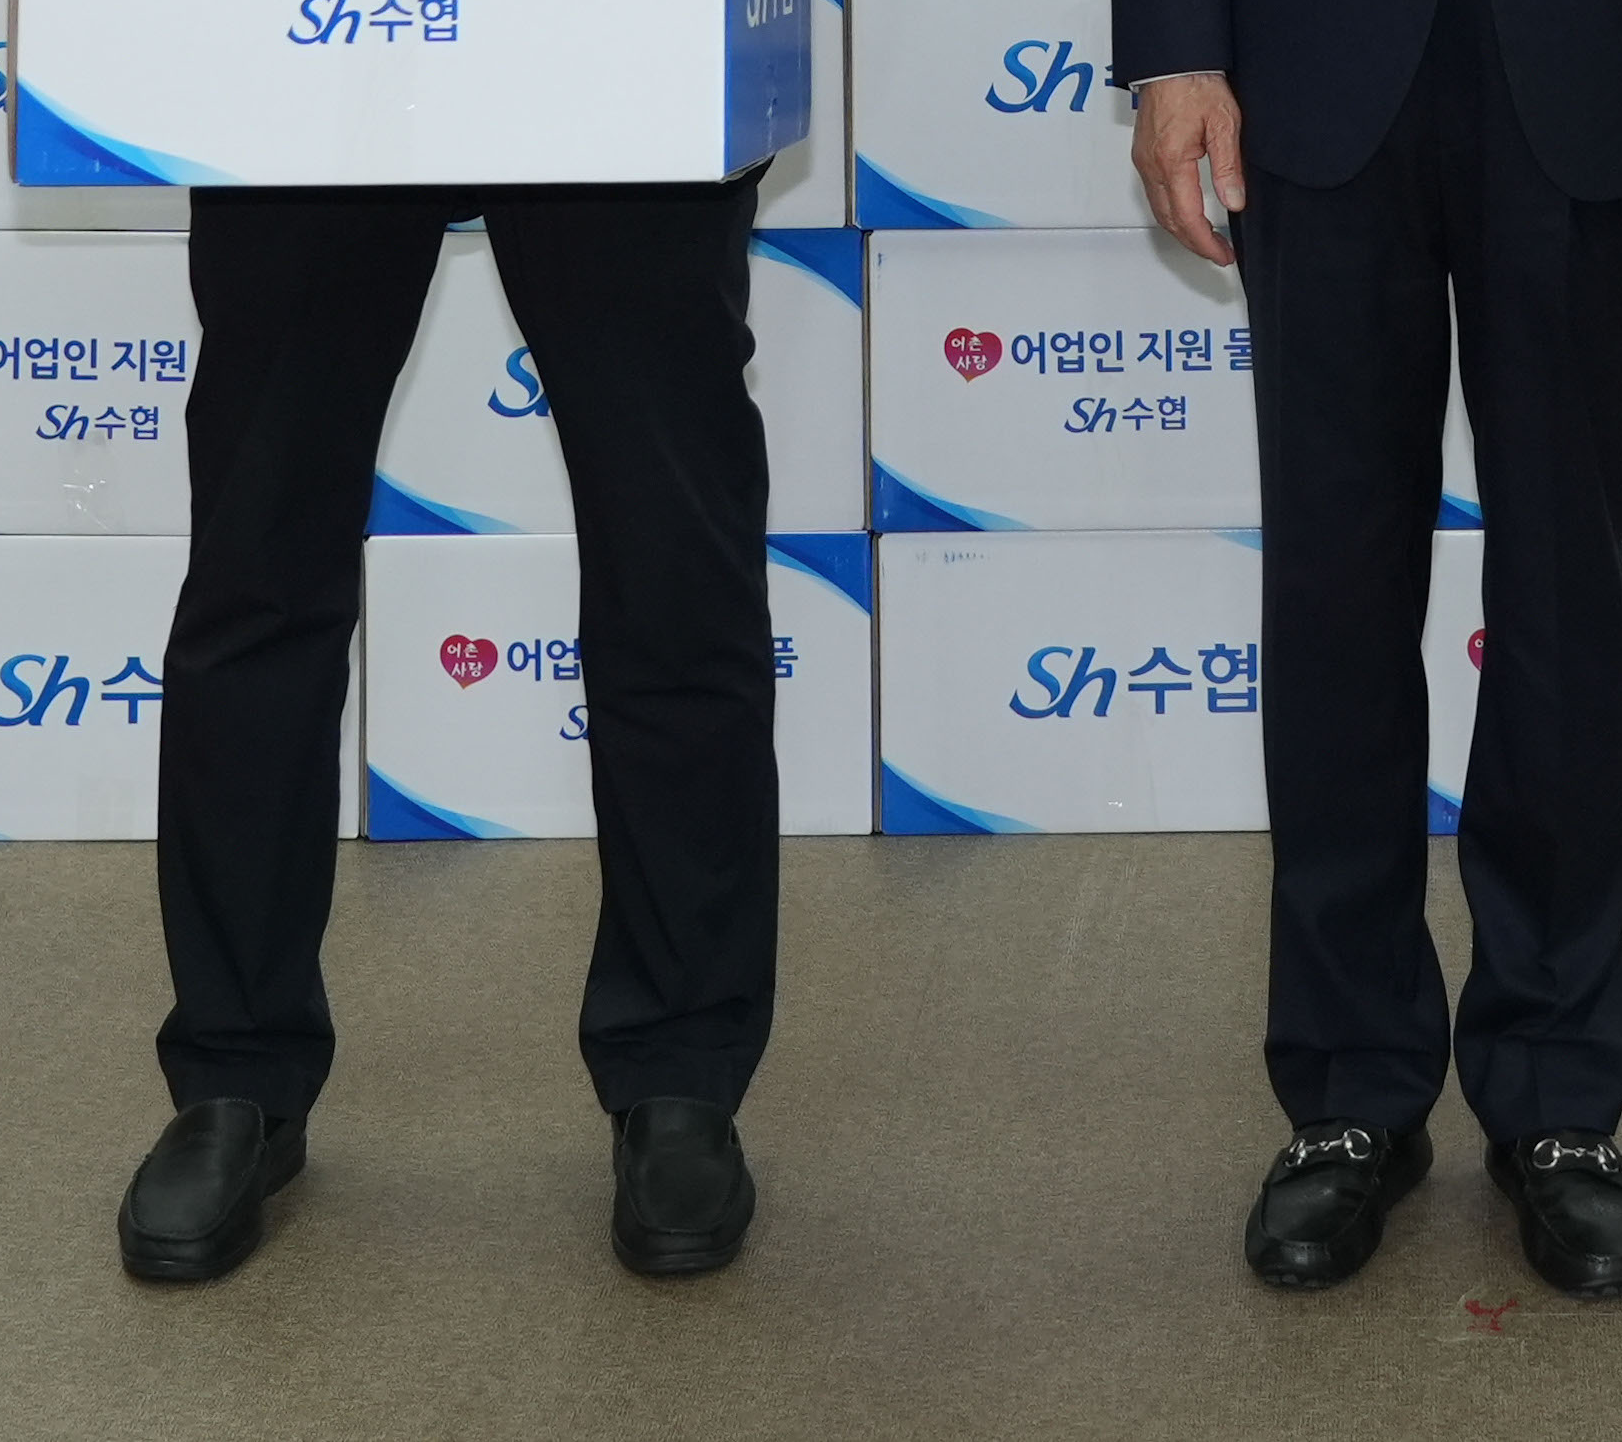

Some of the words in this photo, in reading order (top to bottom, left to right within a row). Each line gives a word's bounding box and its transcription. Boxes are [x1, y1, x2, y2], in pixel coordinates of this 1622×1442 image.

[986, 39, 1114, 113] Sh
[112, 340, 188, 382] 지원
[1012, 331, 1125, 374] 어업인
[1138, 329, 1213, 372] 지원
[1224, 328, 1253, 373] 물
[37, 405, 160, 440] Sh수협
[1064, 397, 1189, 433] Sh수협
[507, 639, 581, 681] 어업
[1010, 642, 1258, 719] Sh수협
